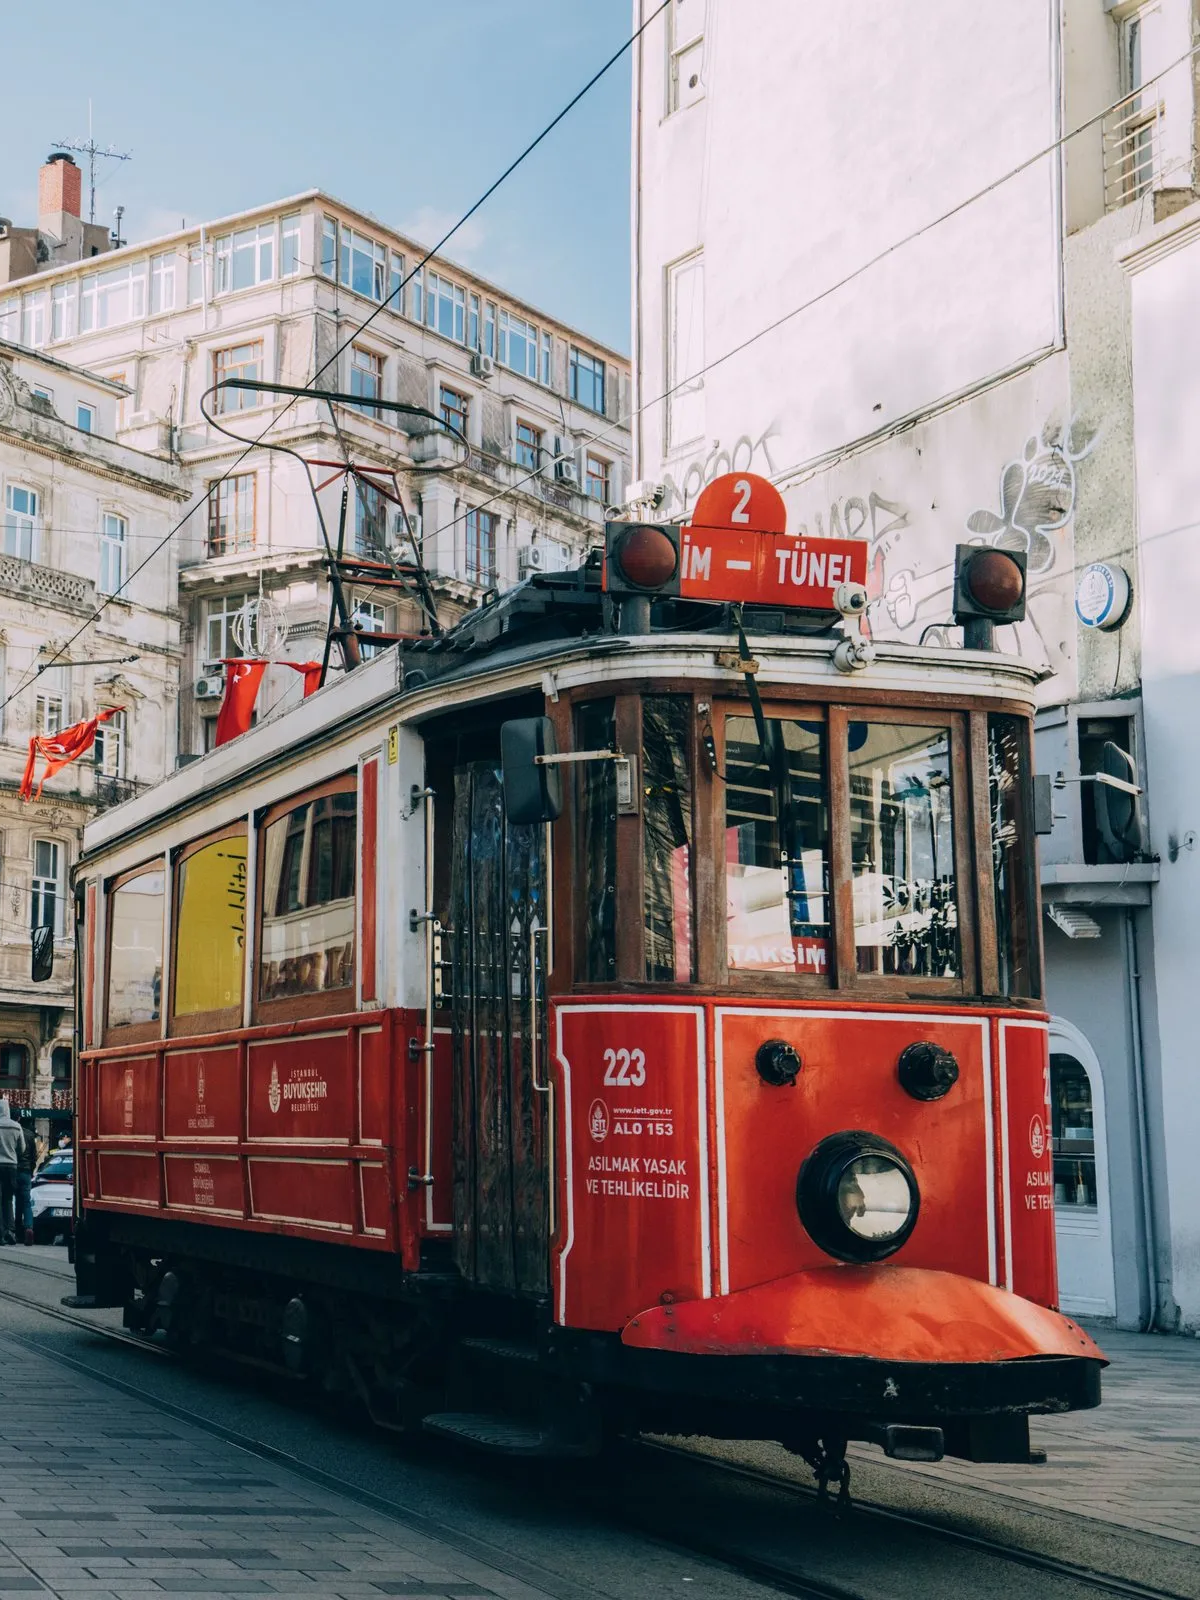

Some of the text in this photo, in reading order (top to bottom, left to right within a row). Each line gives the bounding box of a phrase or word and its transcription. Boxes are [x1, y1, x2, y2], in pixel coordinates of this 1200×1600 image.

[731, 480, 751, 524] 2
[681, 535, 712, 581] İM
[726, 943, 827, 966] TAKSİM
[603, 1048, 646, 1087] 223
[283, 1076, 327, 1103] BÜYÜKŞEHİR
[613, 1107, 673, 1117] www.iett.gov.tr
[613, 1122, 674, 1136] ALO 153
[588, 1156, 687, 1176] ASILMAK YASAK
[586, 1177, 690, 1200] VE TEHLİKELİDİR
[1024, 1194, 1053, 1210] VE TEH
